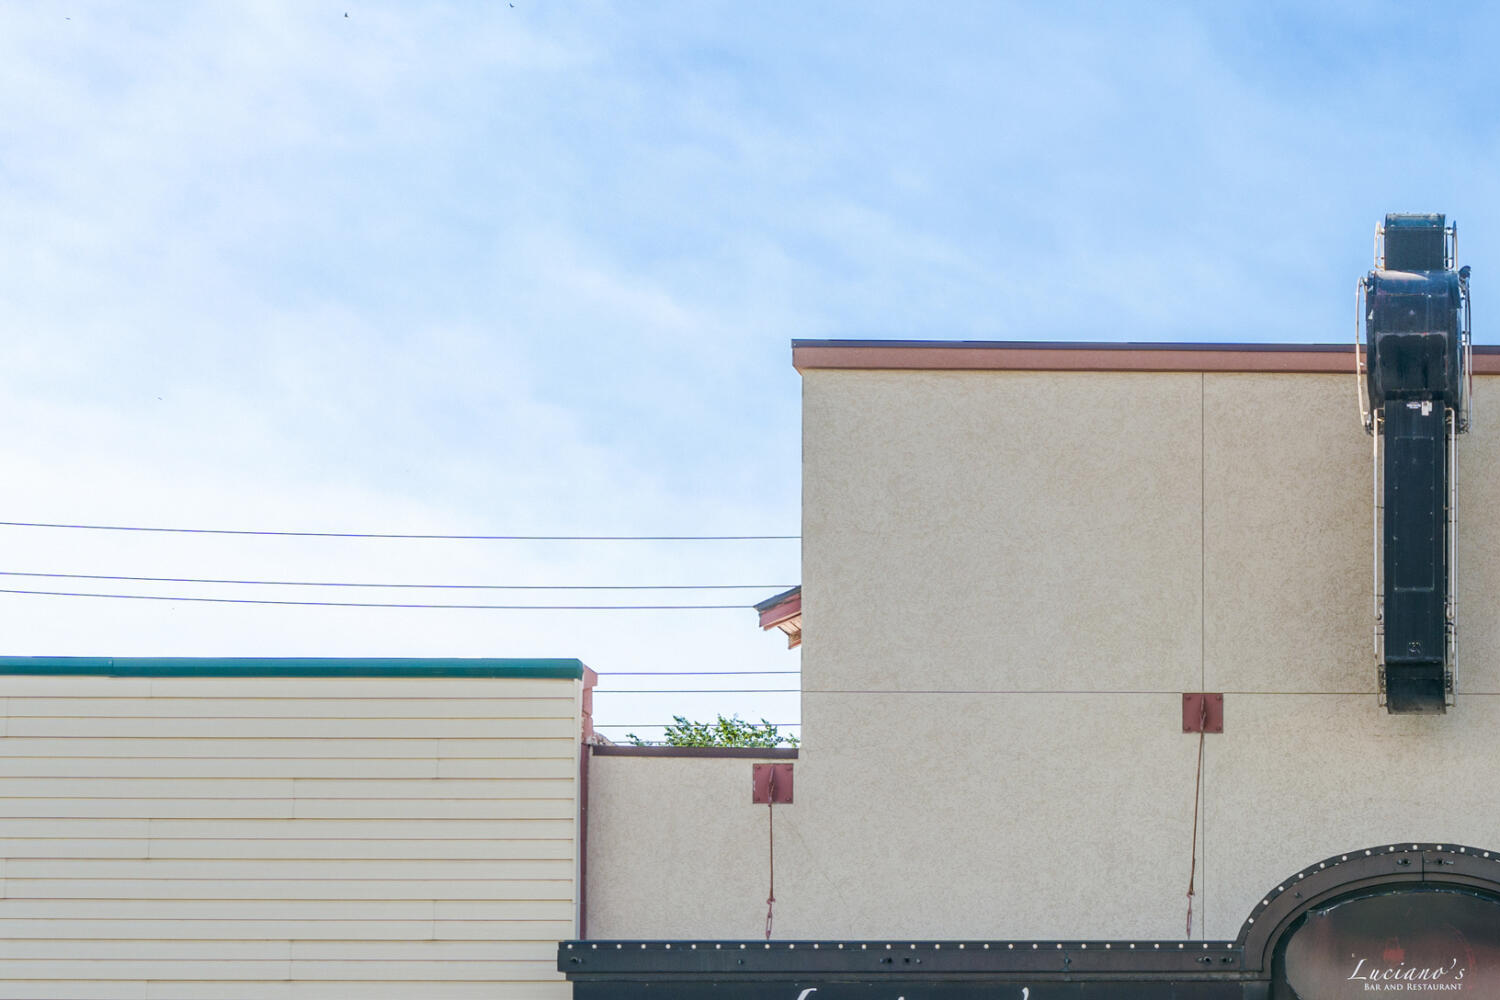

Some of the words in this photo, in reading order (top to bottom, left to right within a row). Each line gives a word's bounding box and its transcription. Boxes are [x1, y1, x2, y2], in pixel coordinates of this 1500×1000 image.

[1347, 958, 1465, 981] Luciano's
[1364, 983, 1381, 991] BAR
[1384, 983, 1403, 991] AND
[1406, 983, 1463, 991] RESTAURANT
